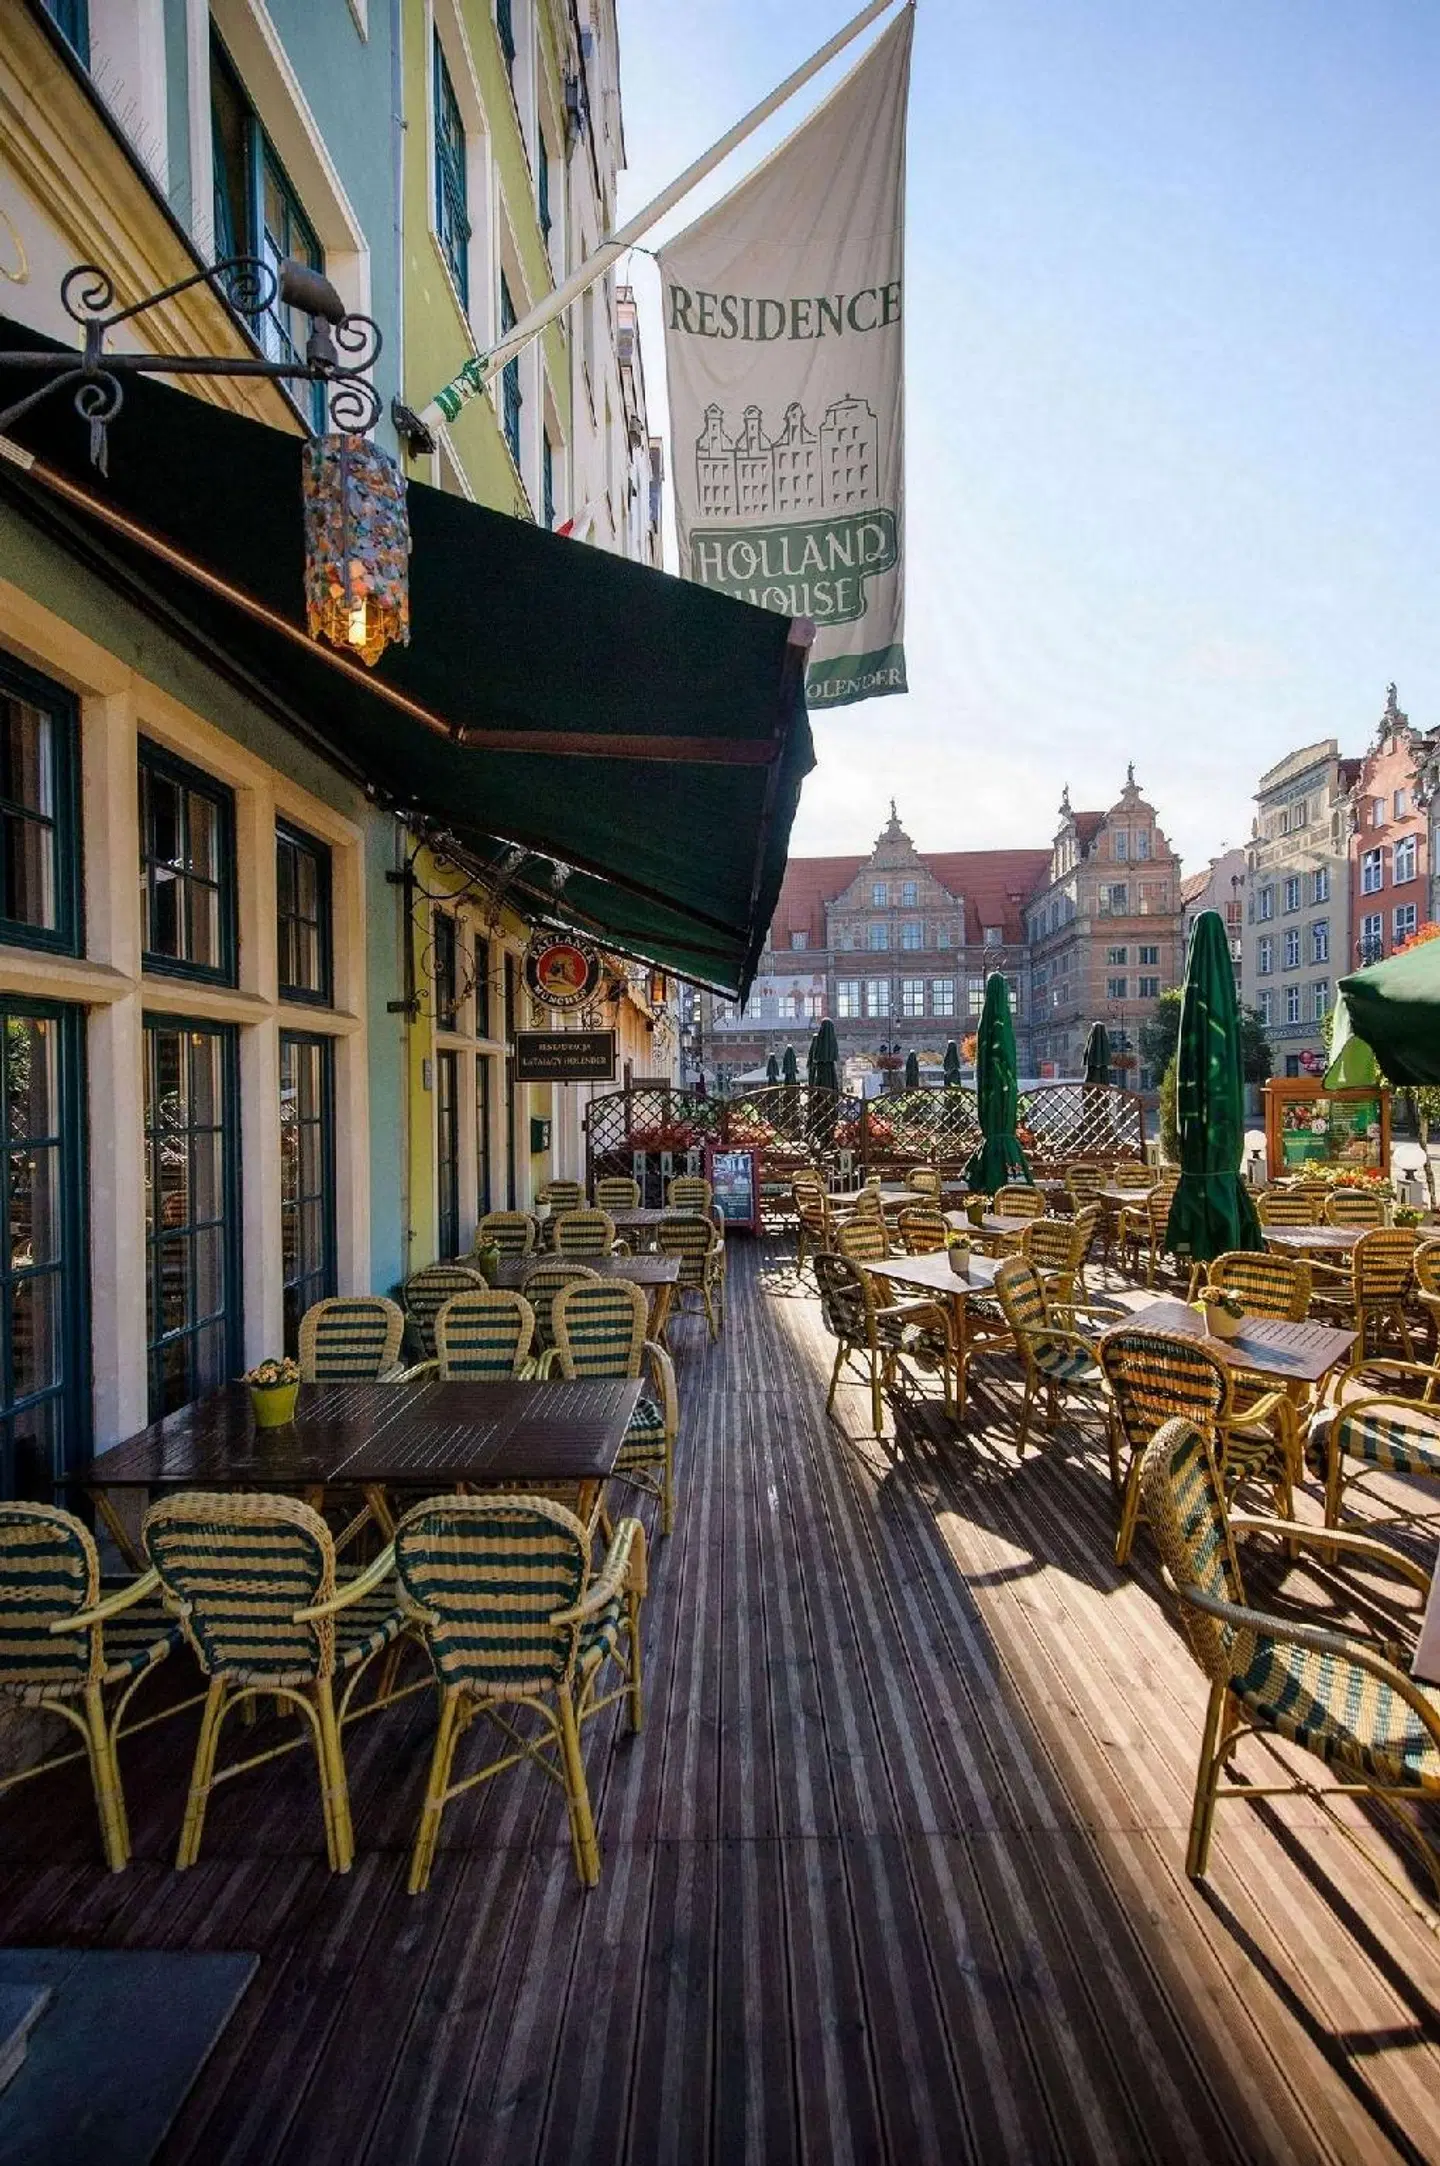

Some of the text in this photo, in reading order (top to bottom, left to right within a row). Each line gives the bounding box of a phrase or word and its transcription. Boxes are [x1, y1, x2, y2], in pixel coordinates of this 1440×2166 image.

[668, 281, 901, 341] RESIDENCE
[698, 523, 889, 583] HOLLAND
[806, 668, 902, 698] OLENDER
[530, 935, 595, 964] PAULANER
